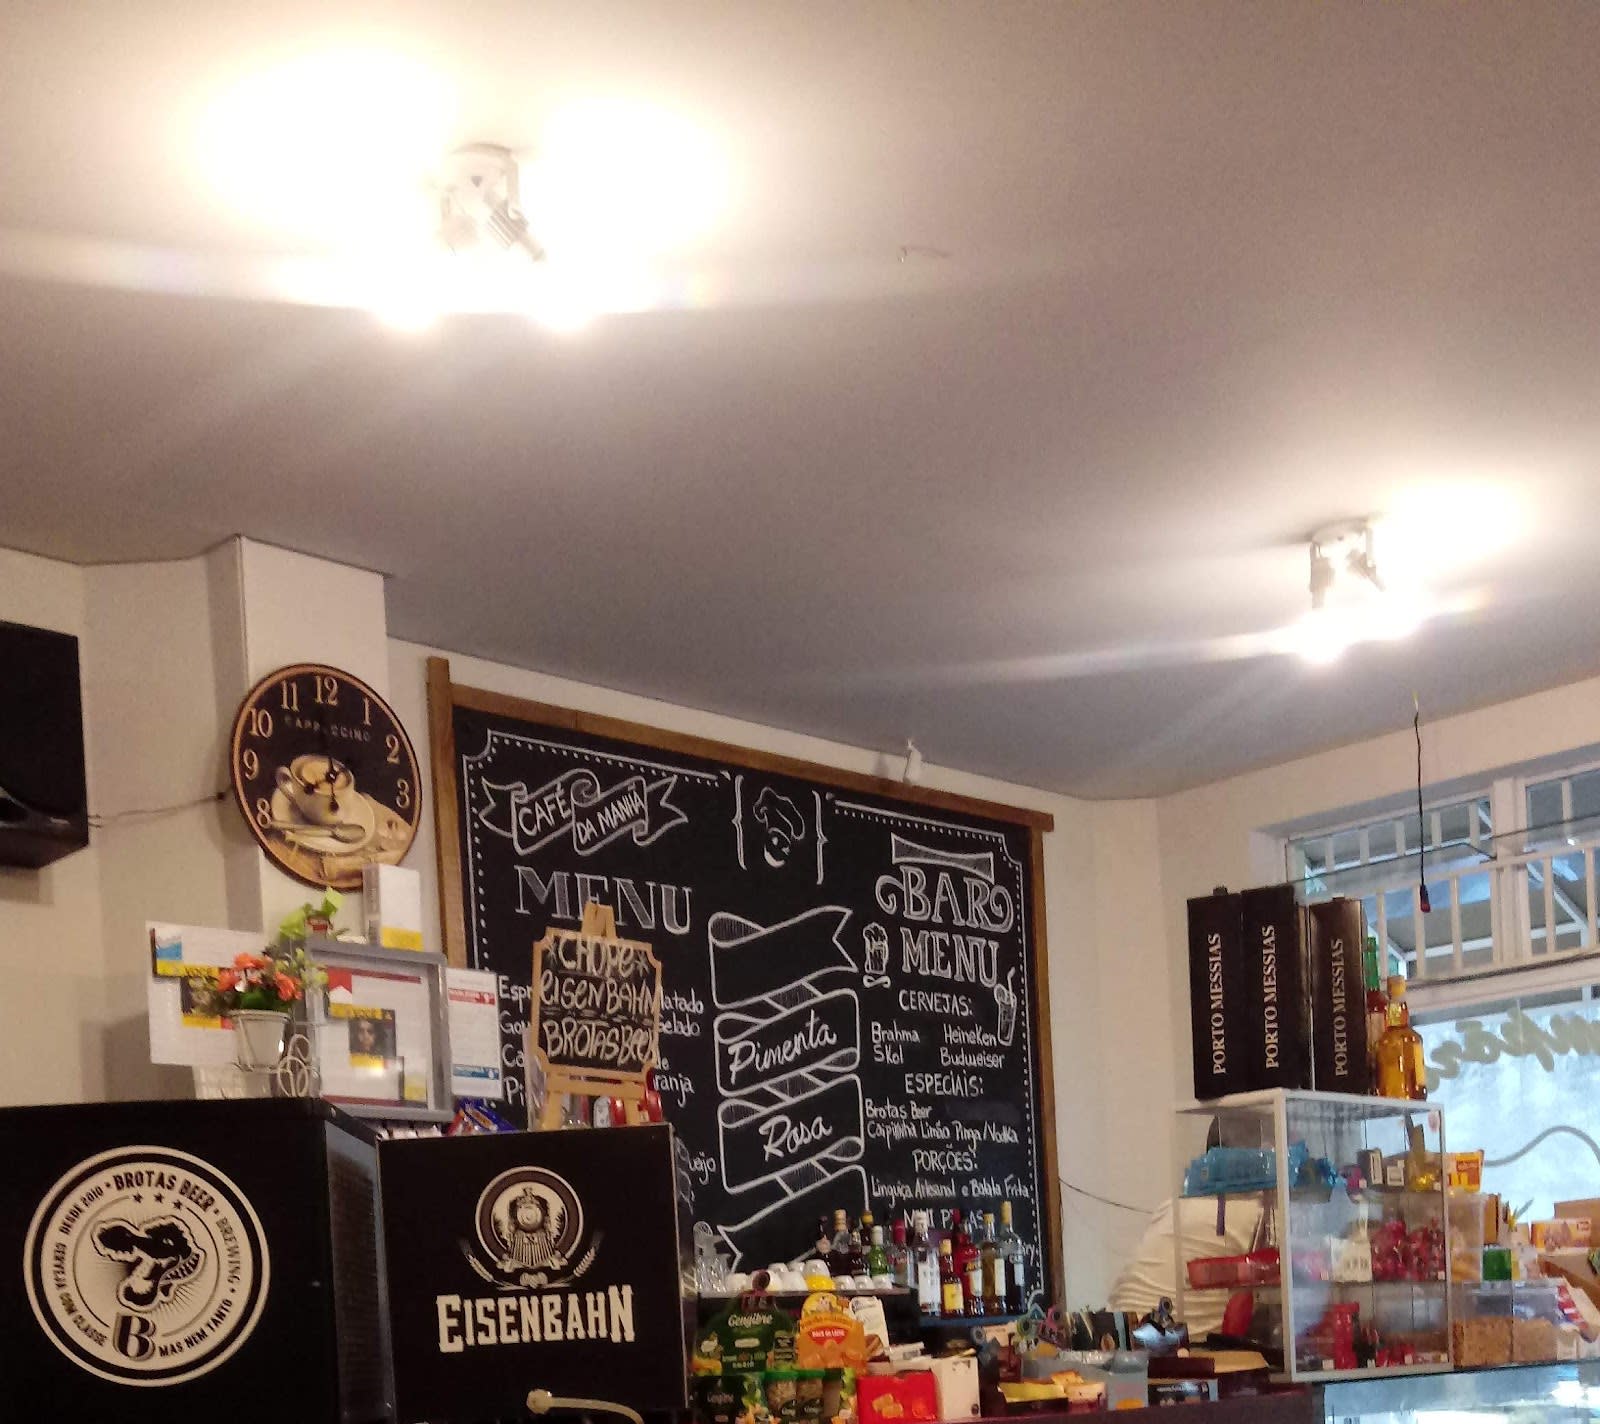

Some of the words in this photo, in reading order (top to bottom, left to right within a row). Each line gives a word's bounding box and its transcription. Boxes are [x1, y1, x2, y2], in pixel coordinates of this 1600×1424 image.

[280, 680, 299, 712] 11
[314, 675, 339, 706] 12
[249, 707, 274, 739] 10
[284, 714, 370, 742] CAPPCCINO
[362, 697, 371, 726] 1
[243, 748, 259, 780] 9
[385, 734, 400, 764] 2
[395, 778, 410, 809] 3
[517, 782, 571, 836] CAFÉ
[256, 797, 272, 829] 8
[575, 821, 597, 845] DA
[514, 865, 692, 934] MENU
[875, 865, 1014, 933] BAR
[900, 927, 1000, 988] MENU
[1208, 933, 1224, 1010] MESSIAS
[1263, 925, 1278, 1004] MESSIAS
[1331, 938, 1347, 1014] MESSIAS
[728, 1009, 837, 1085] Pimenta
[871, 1020, 921, 1044] Brahma
[1210, 1013, 1226, 1075] PORTO
[1264, 1006, 1280, 1069] PORTO
[1333, 1016, 1348, 1077] PORTO
[940, 1047, 1005, 1069] Budweiser
[865, 1096, 907, 1119] Brotas
[759, 1115, 833, 1162] Rosa
[113, 1170, 177, 1191] BROTAS
[179, 1178, 216, 1213] BEER
[436, 1284, 636, 1353] EISENBAHN
[158, 1341, 183, 1358] MAS
[184, 1327, 209, 1349] NEM
